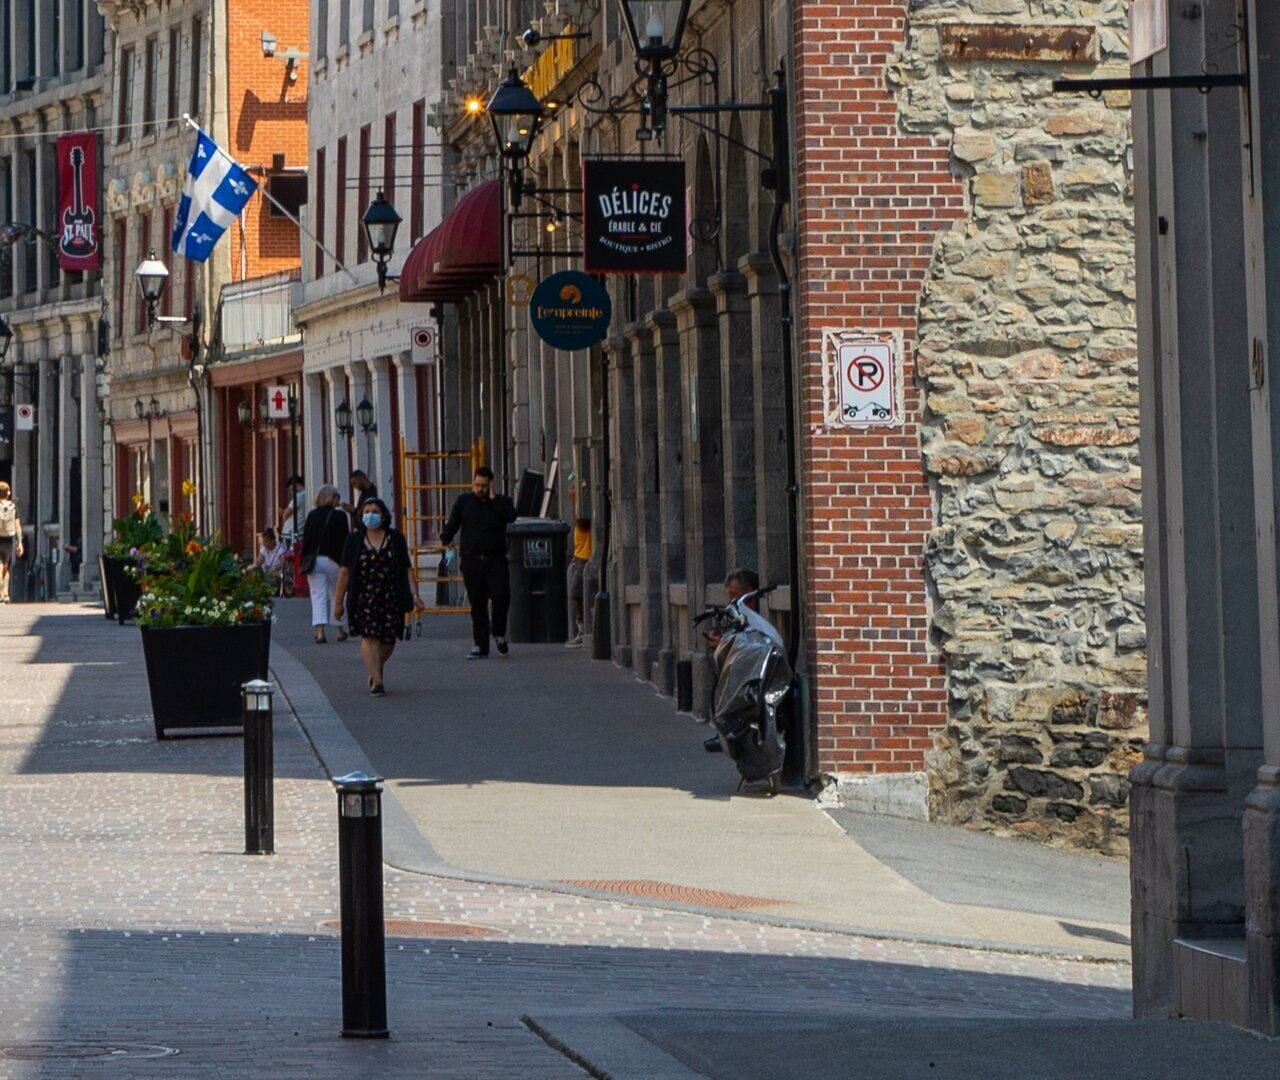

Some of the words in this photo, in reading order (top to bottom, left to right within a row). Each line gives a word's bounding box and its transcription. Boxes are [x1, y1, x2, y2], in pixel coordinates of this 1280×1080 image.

[599, 186, 672, 219] DÉLICES
[608, 219, 635, 233] ÉRABLE
[650, 222, 662, 233] CIE
[600, 236, 639, 253] BOUTIQUE
[646, 236, 673, 251] BISTRO
